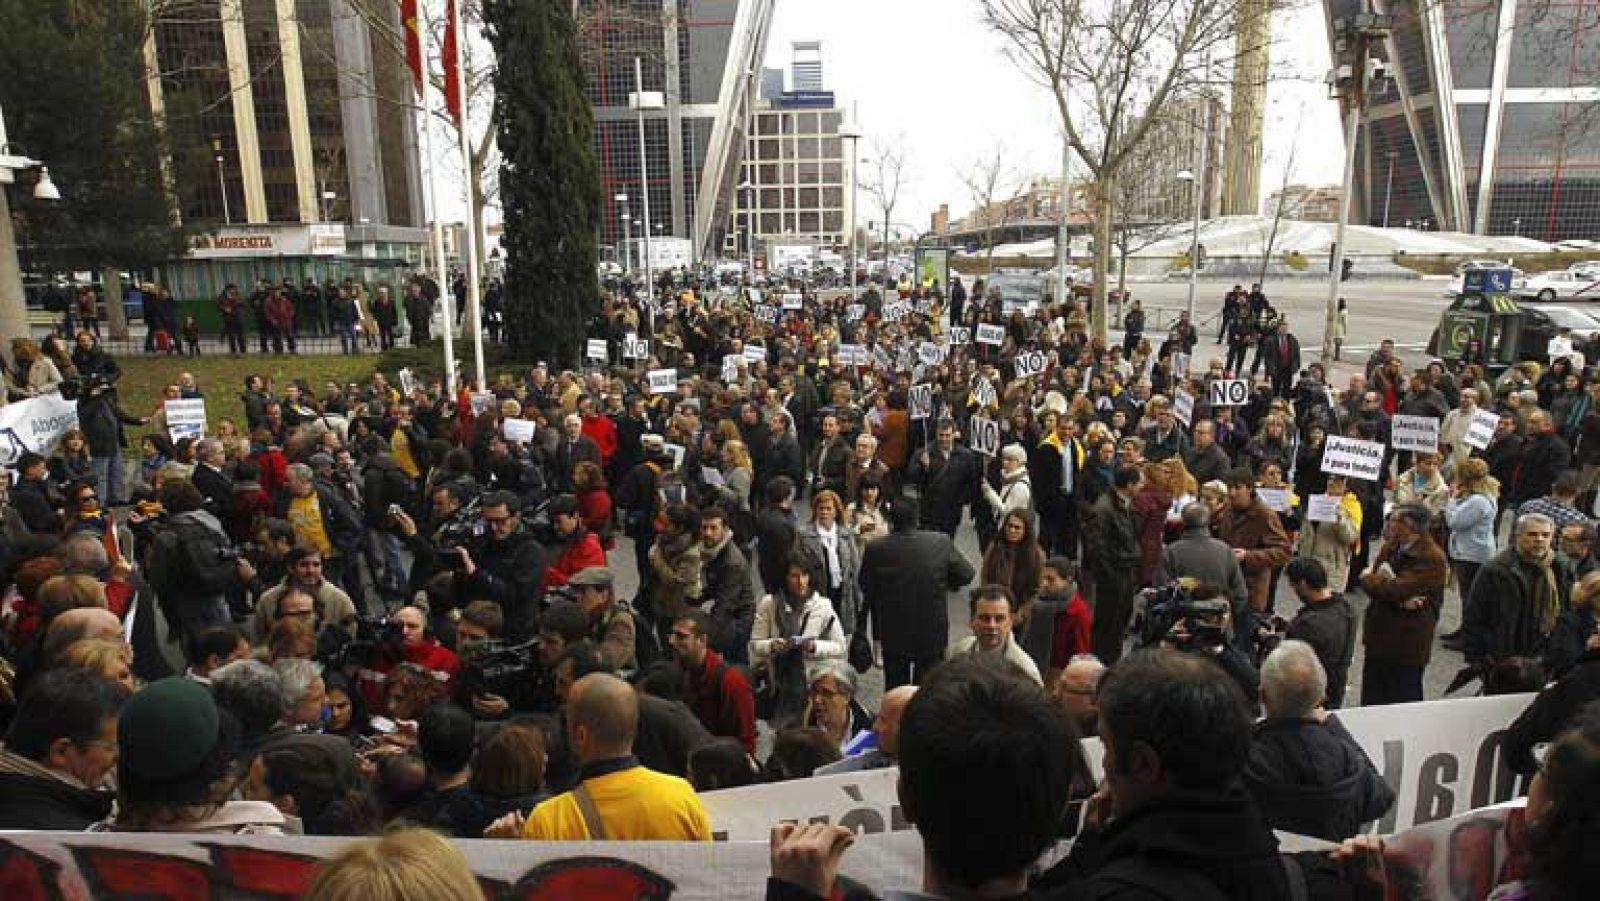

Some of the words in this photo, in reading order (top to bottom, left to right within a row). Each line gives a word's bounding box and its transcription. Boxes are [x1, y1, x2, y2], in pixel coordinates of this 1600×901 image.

[623, 340, 647, 357] NO
[1016, 354, 1042, 374] NO
[1211, 382, 1246, 403] NO
[972, 418, 995, 452] NO
